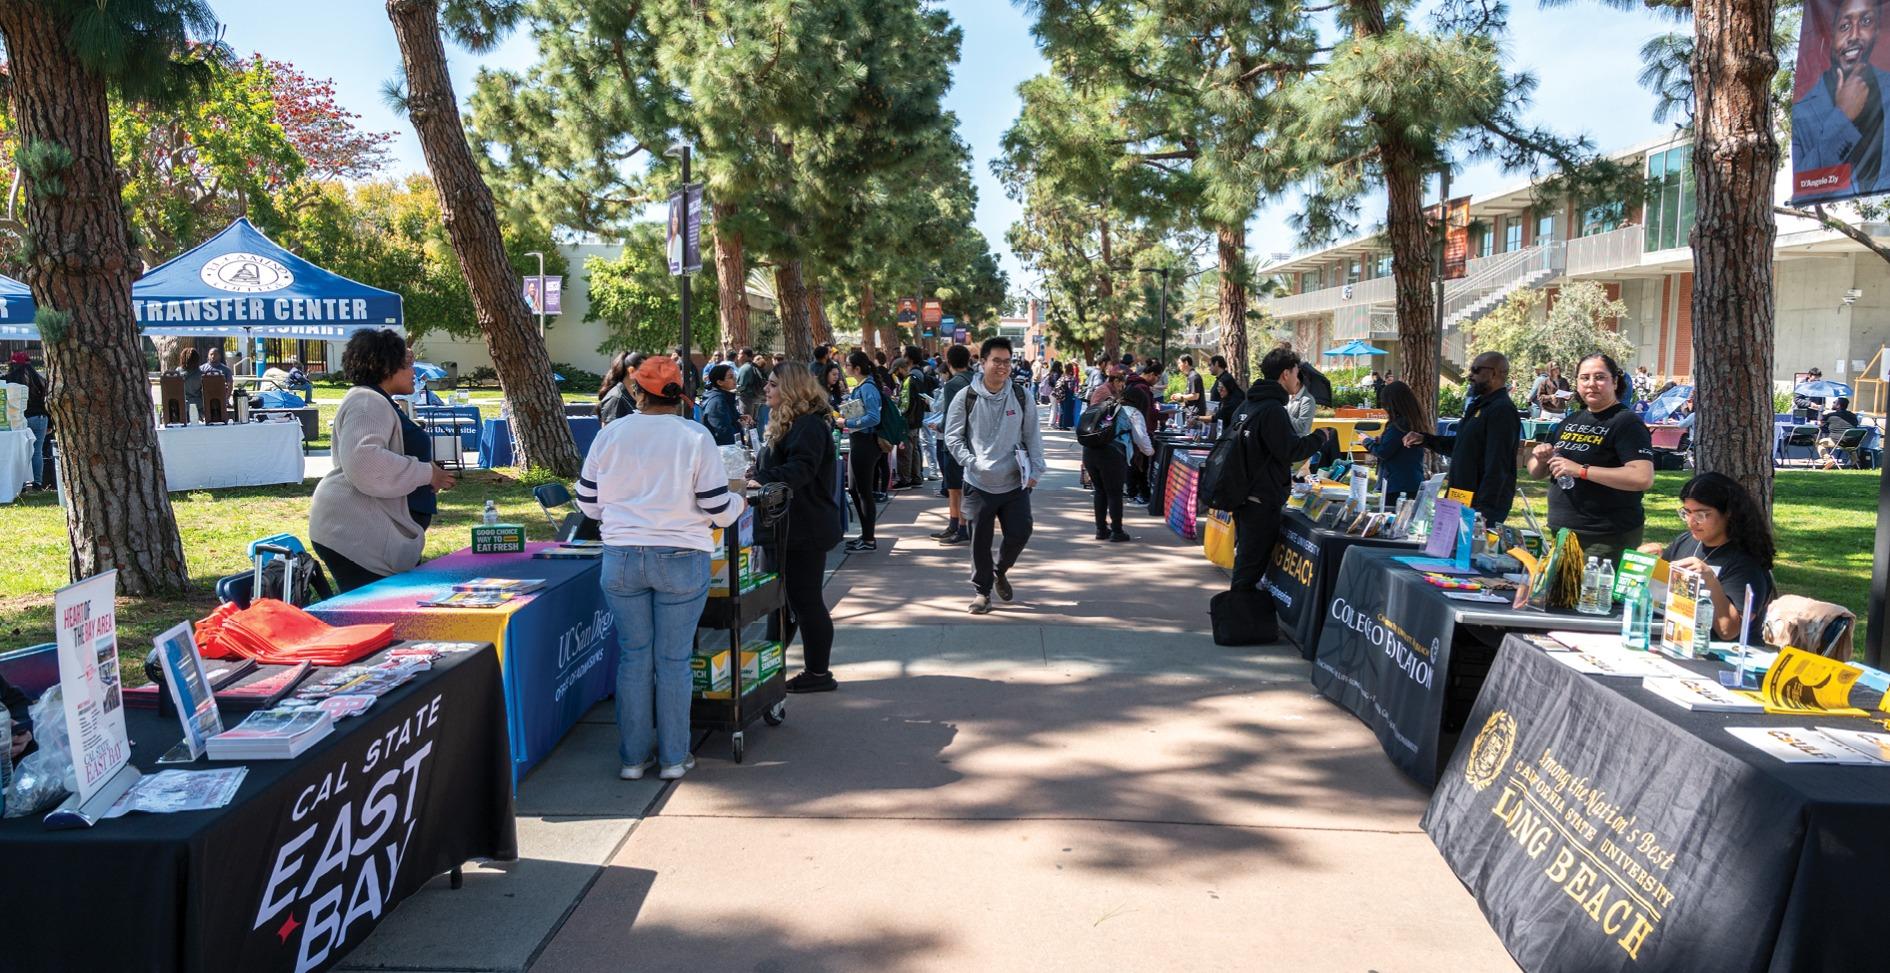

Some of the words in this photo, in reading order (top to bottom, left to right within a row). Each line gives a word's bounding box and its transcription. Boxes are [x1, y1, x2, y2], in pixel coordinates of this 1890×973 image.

[1800, 177, 1828, 188] D'Angelo
[134, 298, 265, 322] TRANSFER
[274, 298, 368, 321] CENTER
[1571, 433, 1604, 445] TEACH
[1578, 424, 1610, 436] BEACH
[1564, 442, 1590, 452] LEAD
[476, 535, 492, 544] WAY
[493, 535, 503, 543] TO
[476, 543, 493, 552] EAT
[493, 542, 519, 551] FRESH
[63, 602, 84, 630] HEART
[83, 599, 91, 621] OF
[73, 623, 85, 648] THE
[84, 618, 96, 642] BAY
[96, 612, 113, 637] AREA
[558, 626, 575, 669] UC
[572, 621, 591, 656] San
[291, 761, 348, 822] CAL
[362, 693, 442, 774] STATE
[1538, 747, 1569, 790] Among
[1569, 776, 1588, 801] the
[1584, 788, 1640, 842] Nation's
[1636, 832, 1676, 871] Best
[252, 739, 434, 932] EAST
[1564, 807, 1598, 842] STATE
[1600, 838, 1676, 908] UNIVERSITY
[293, 817, 417, 973] BAY
[1545, 845, 1655, 961] BEACH
